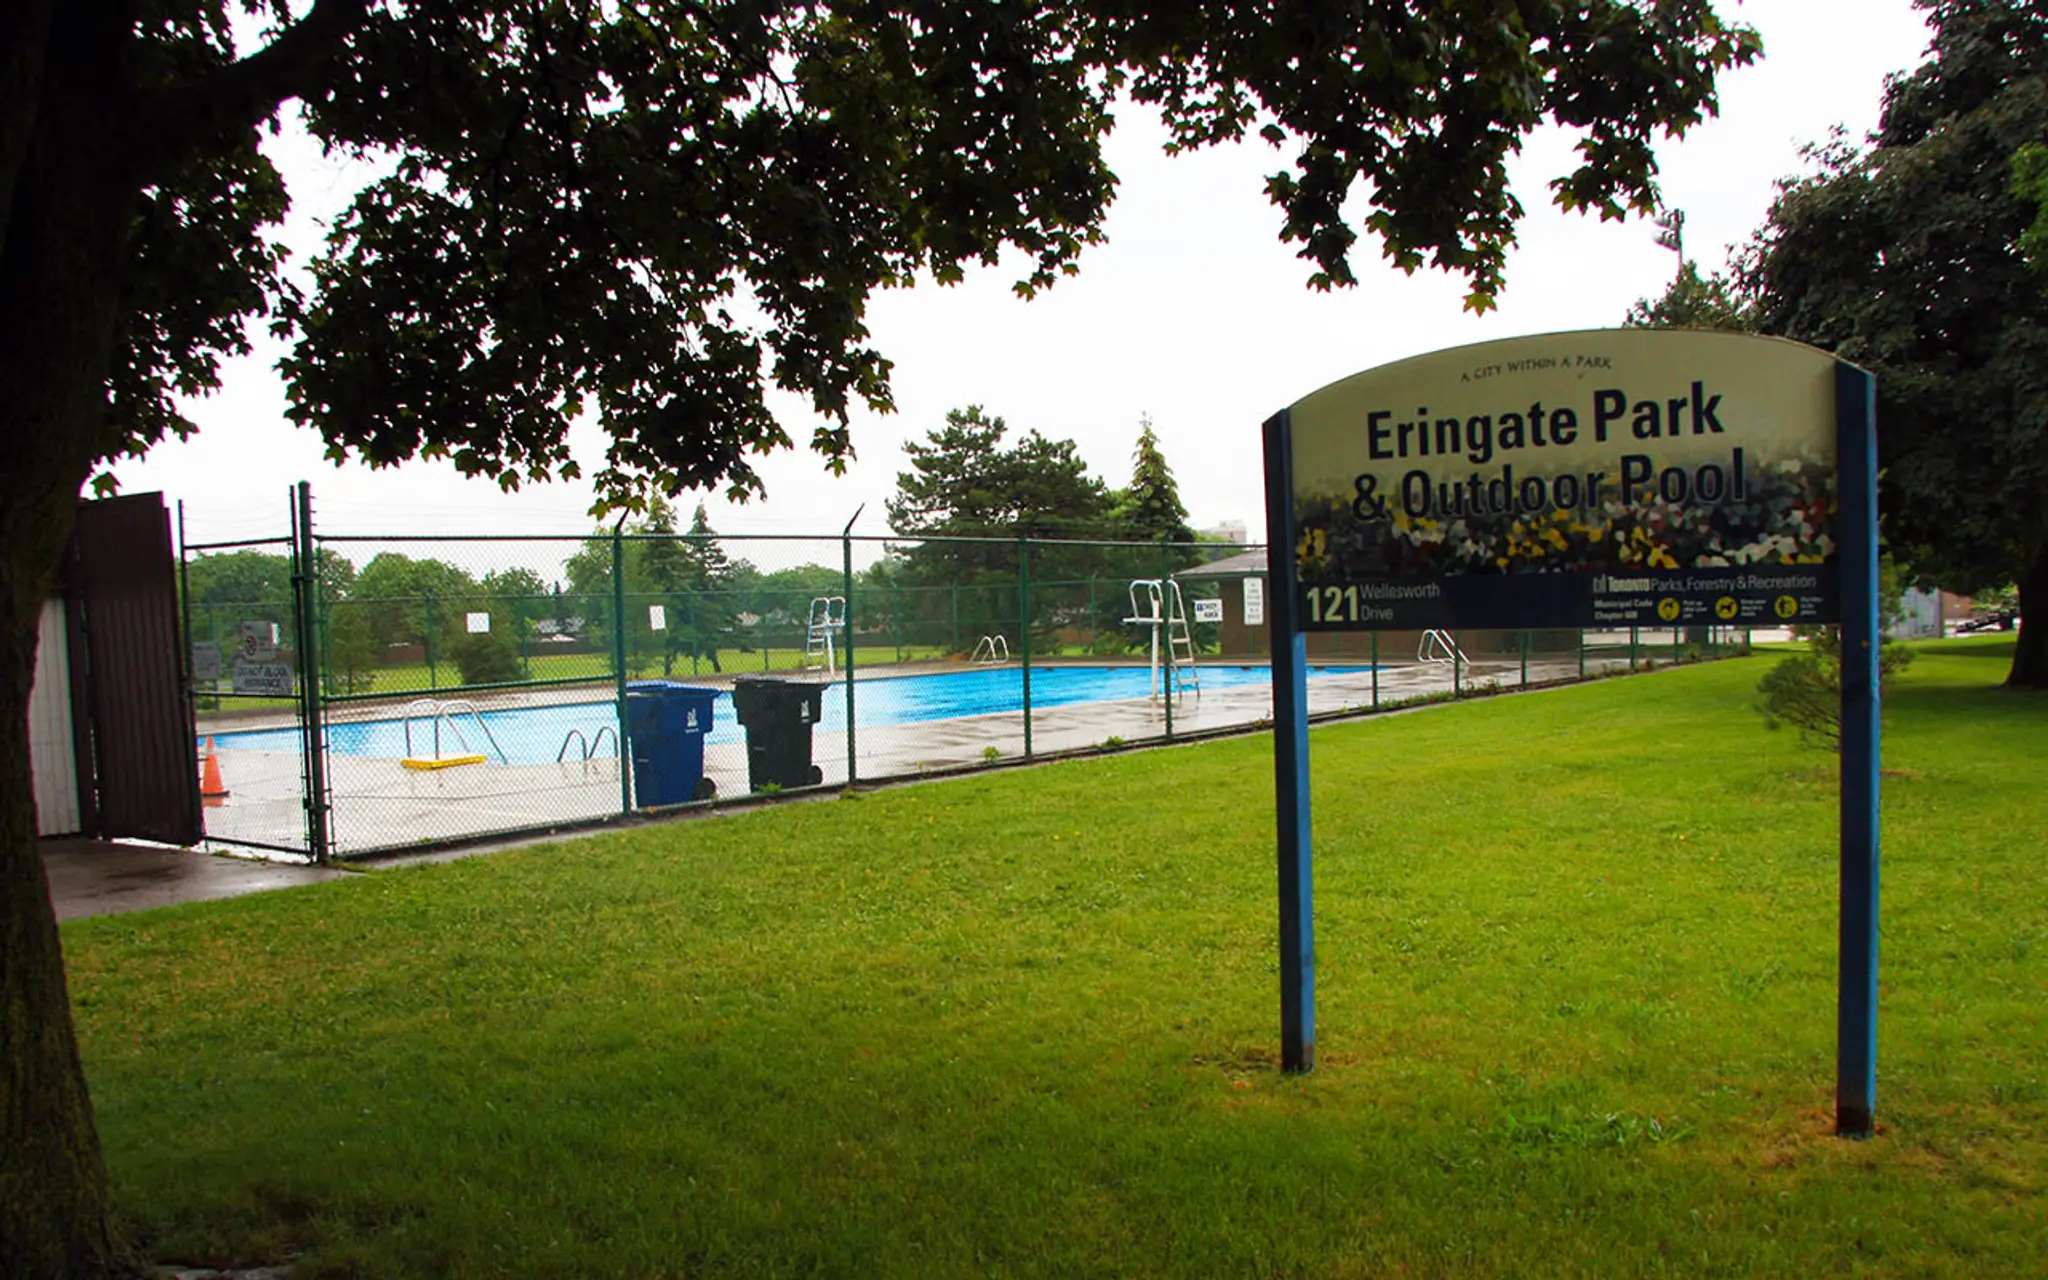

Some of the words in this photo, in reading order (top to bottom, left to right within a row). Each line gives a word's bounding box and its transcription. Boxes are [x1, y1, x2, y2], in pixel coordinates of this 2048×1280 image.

[1461, 373, 1471, 383] A
[1474, 365, 1501, 380] CITY
[1507, 358, 1556, 372] WITHIN
[1561, 356, 1570, 368] A
[1576, 355, 1612, 369] PARK
[1367, 401, 1578, 464] Eringate
[1594, 381, 1725, 442] Park
[1353, 473, 1387, 520] &
[1402, 464, 1605, 518] Outdoor
[1620, 447, 1744, 505] Pool
[1651, 578, 1686, 593] Parks,
[1687, 577, 1735, 592] Forestry
[1737, 575, 1747, 590] &
[1748, 574, 1817, 590] Recreation
[1307, 585, 1358, 622] 121
[1360, 582, 1440, 600] Wellesworth
[1361, 604, 1393, 620] Drive
